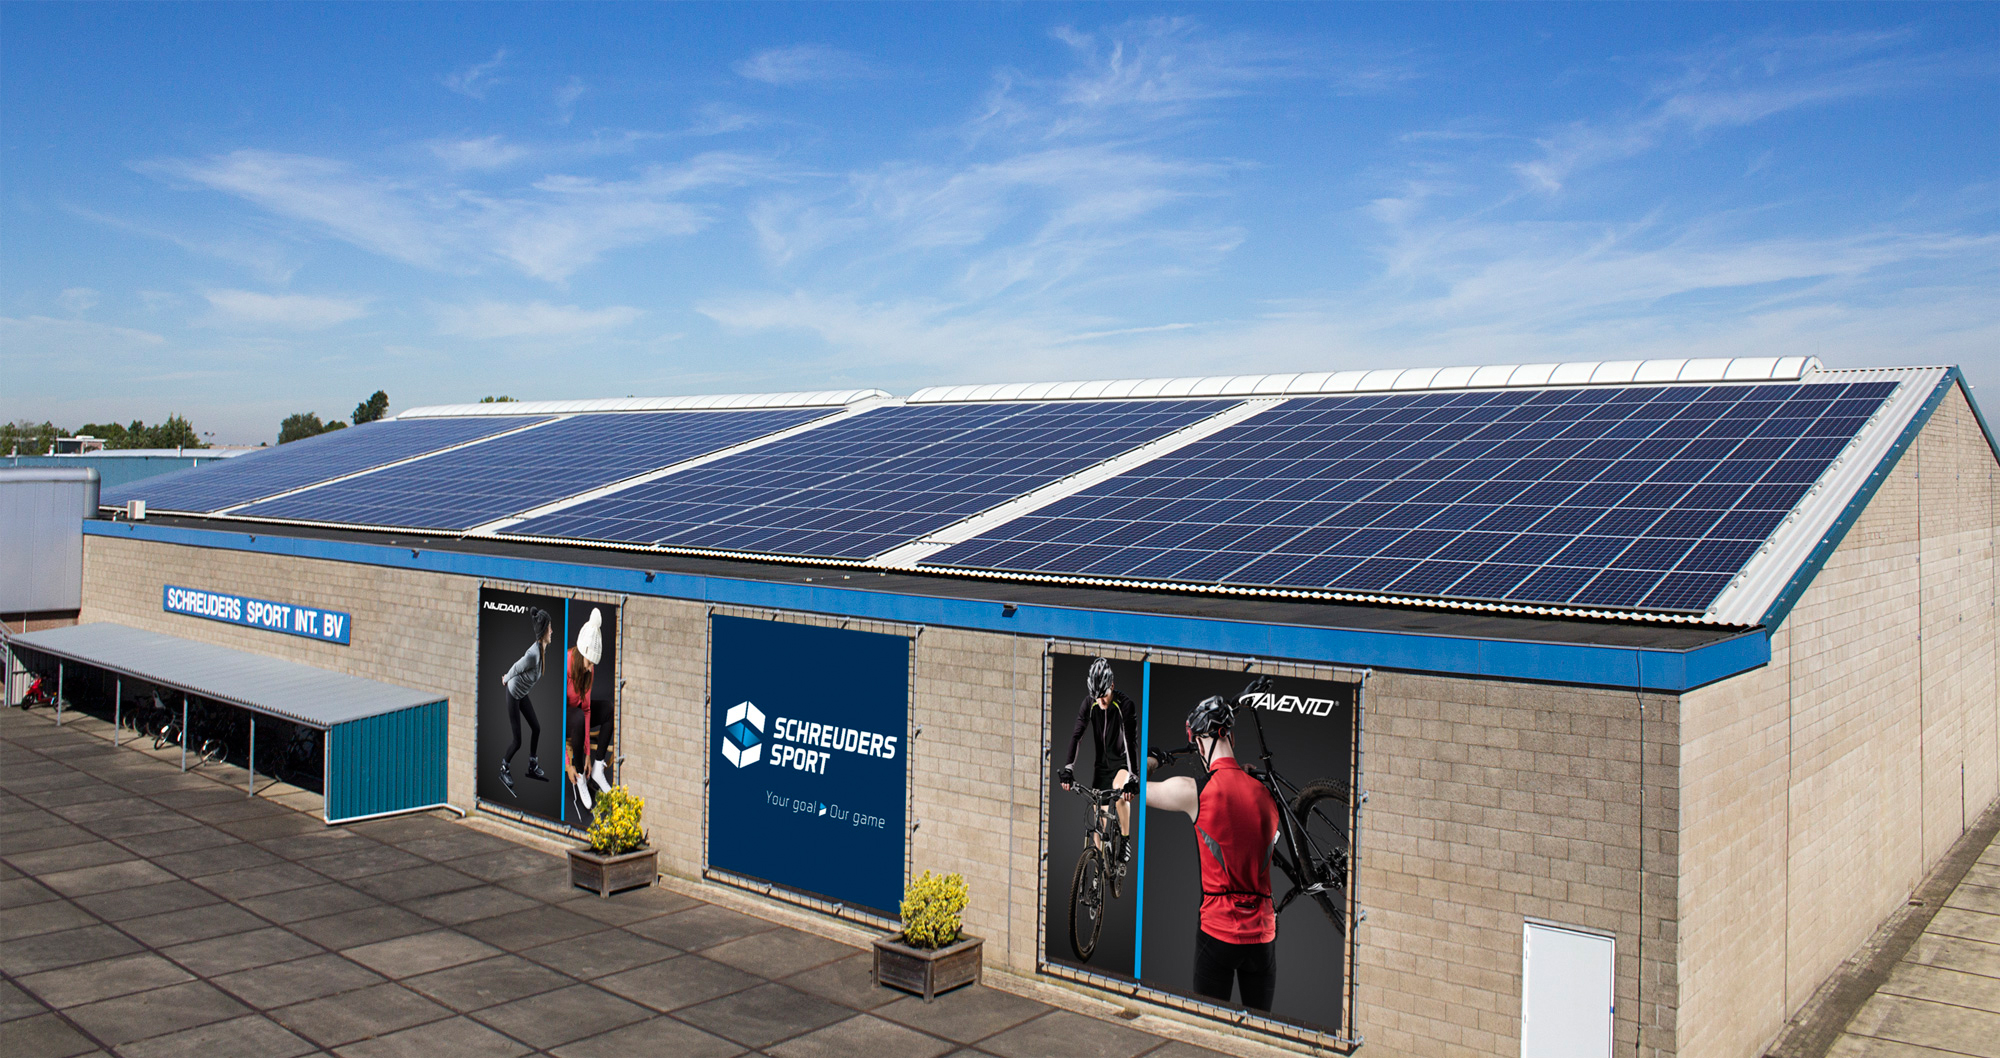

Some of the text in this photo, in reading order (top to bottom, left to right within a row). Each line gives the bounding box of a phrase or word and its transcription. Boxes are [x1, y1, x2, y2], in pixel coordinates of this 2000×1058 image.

[168, 588, 343, 638] SCHREUDERS SPORT INT. BV
[1252, 692, 1335, 717] AVENTO
[773, 717, 897, 759] SCHREUDERS
[769, 743, 831, 775] SPORT
[766, 790, 886, 829] Your goal Our game
